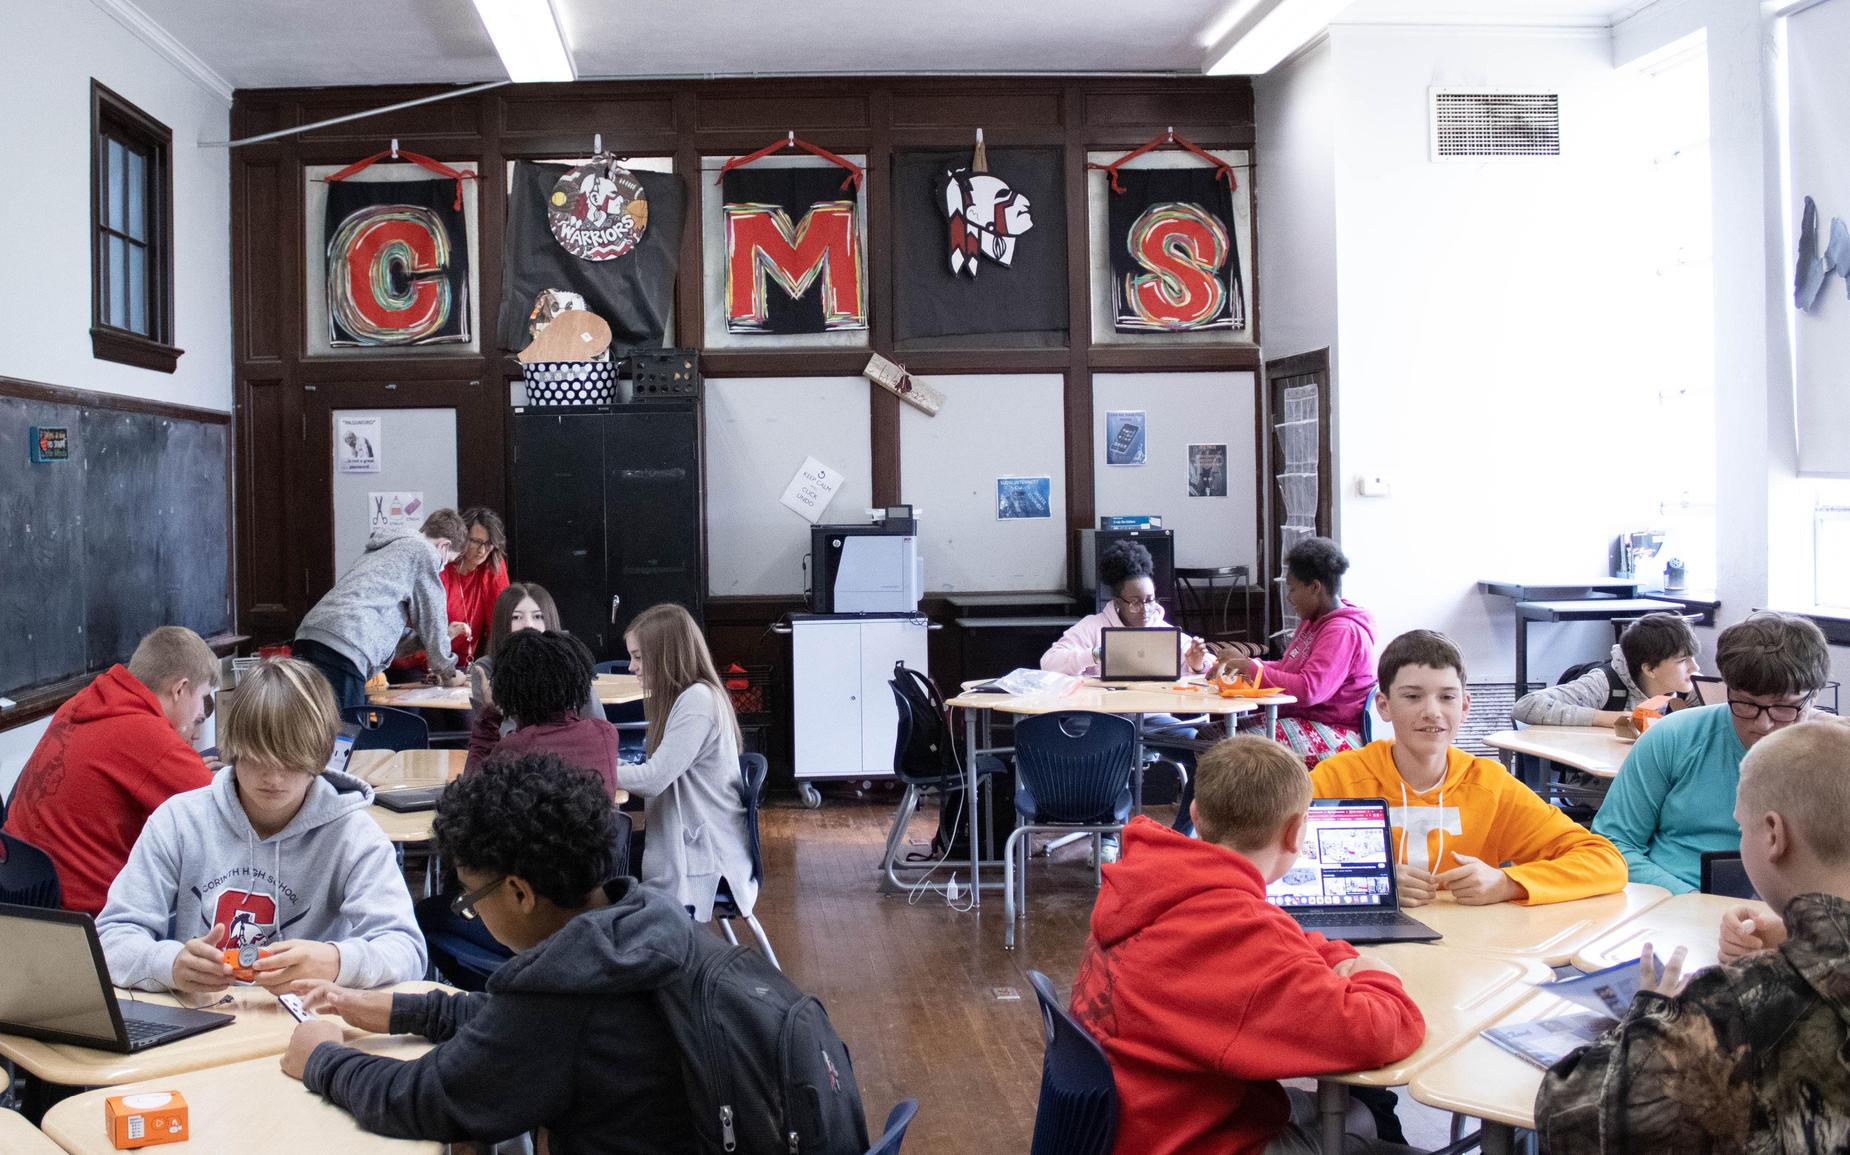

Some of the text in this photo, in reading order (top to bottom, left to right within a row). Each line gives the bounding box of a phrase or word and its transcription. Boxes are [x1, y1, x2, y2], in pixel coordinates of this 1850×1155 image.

[561, 215, 634, 247] WARRIORS
[329, 206, 450, 342] C
[724, 202, 867, 328] M
[1128, 204, 1228, 327] S
[816, 480, 831, 492] CALM
[1389, 806, 1462, 872] T
[203, 868, 240, 893] CORINTH
[242, 867, 266, 880] HGH
